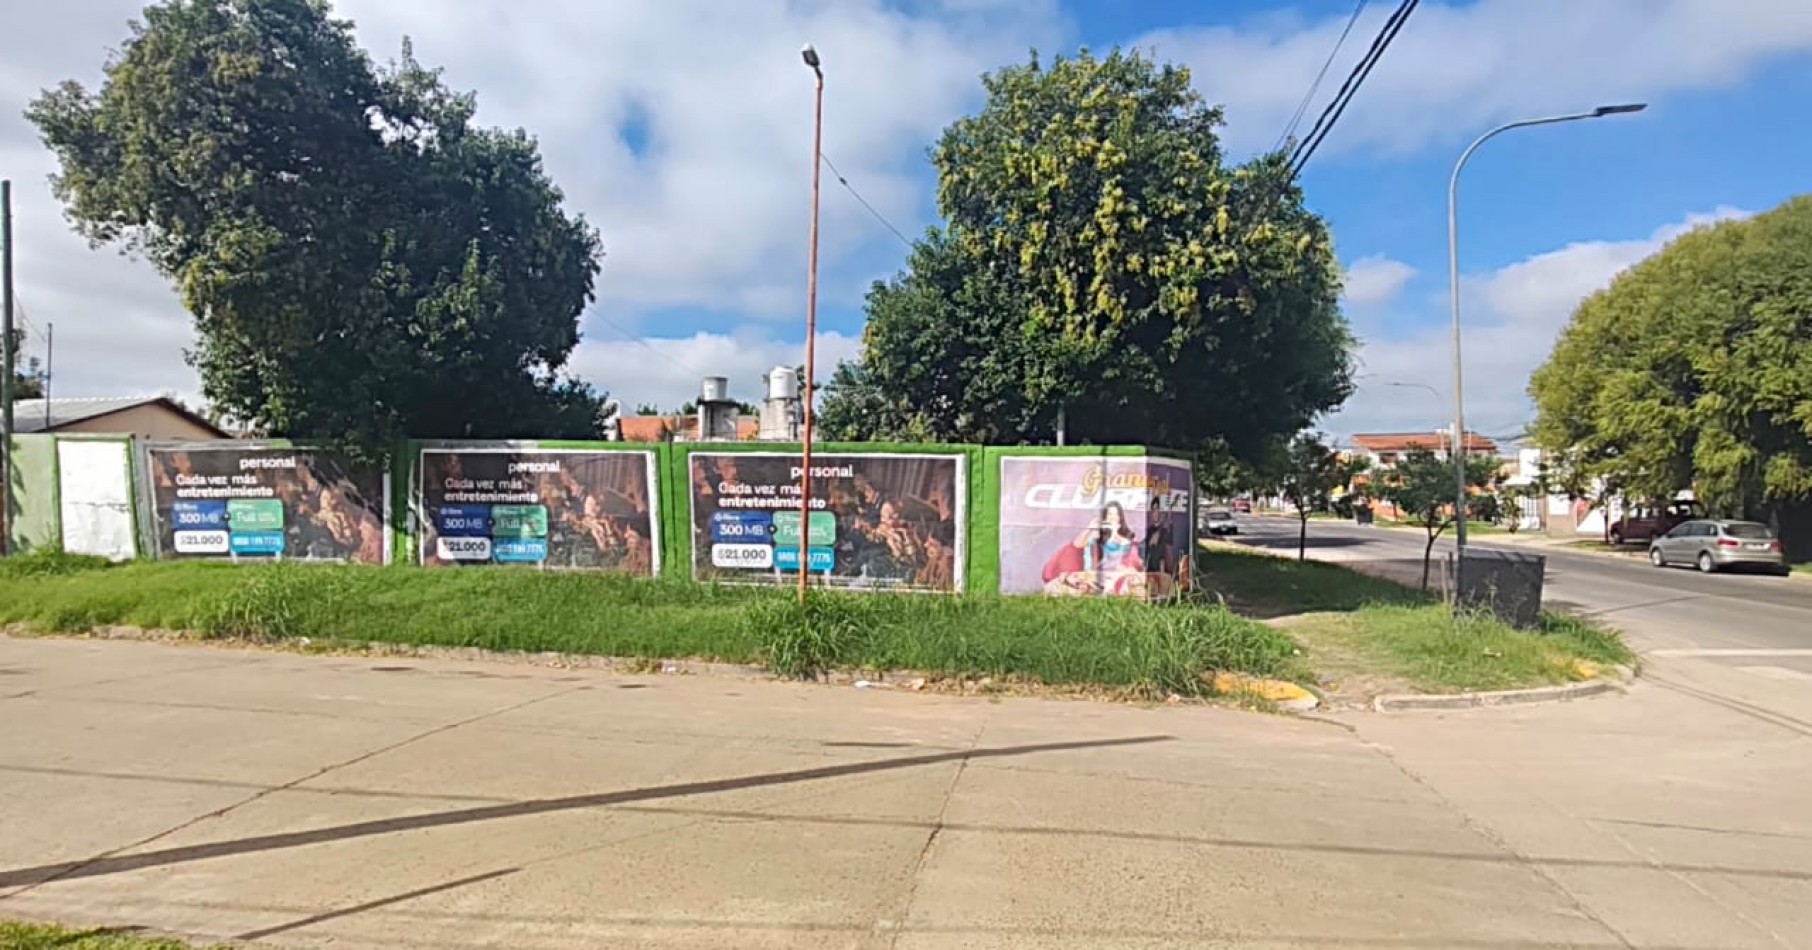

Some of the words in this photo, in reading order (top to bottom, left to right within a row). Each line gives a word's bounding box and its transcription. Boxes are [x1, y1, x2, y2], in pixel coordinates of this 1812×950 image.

[239, 456, 296, 470] personal
[508, 461, 560, 474] personal
[175, 474, 206, 485] Cada
[207, 476, 227, 485] vez
[232, 473, 257, 485] más
[444, 478, 474, 490] Cada
[476, 480, 494, 490] vez
[499, 478, 523, 490] más
[176, 487, 274, 498] entretenimiento
[718, 482, 752, 494] Cada
[754, 484, 776, 495] vez
[444, 491, 539, 502] entretenimiento
[179, 513, 201, 523] 300
[443, 518, 465, 529] 300
[719, 524, 743, 535] 300
[745, 525, 764, 535] MB
